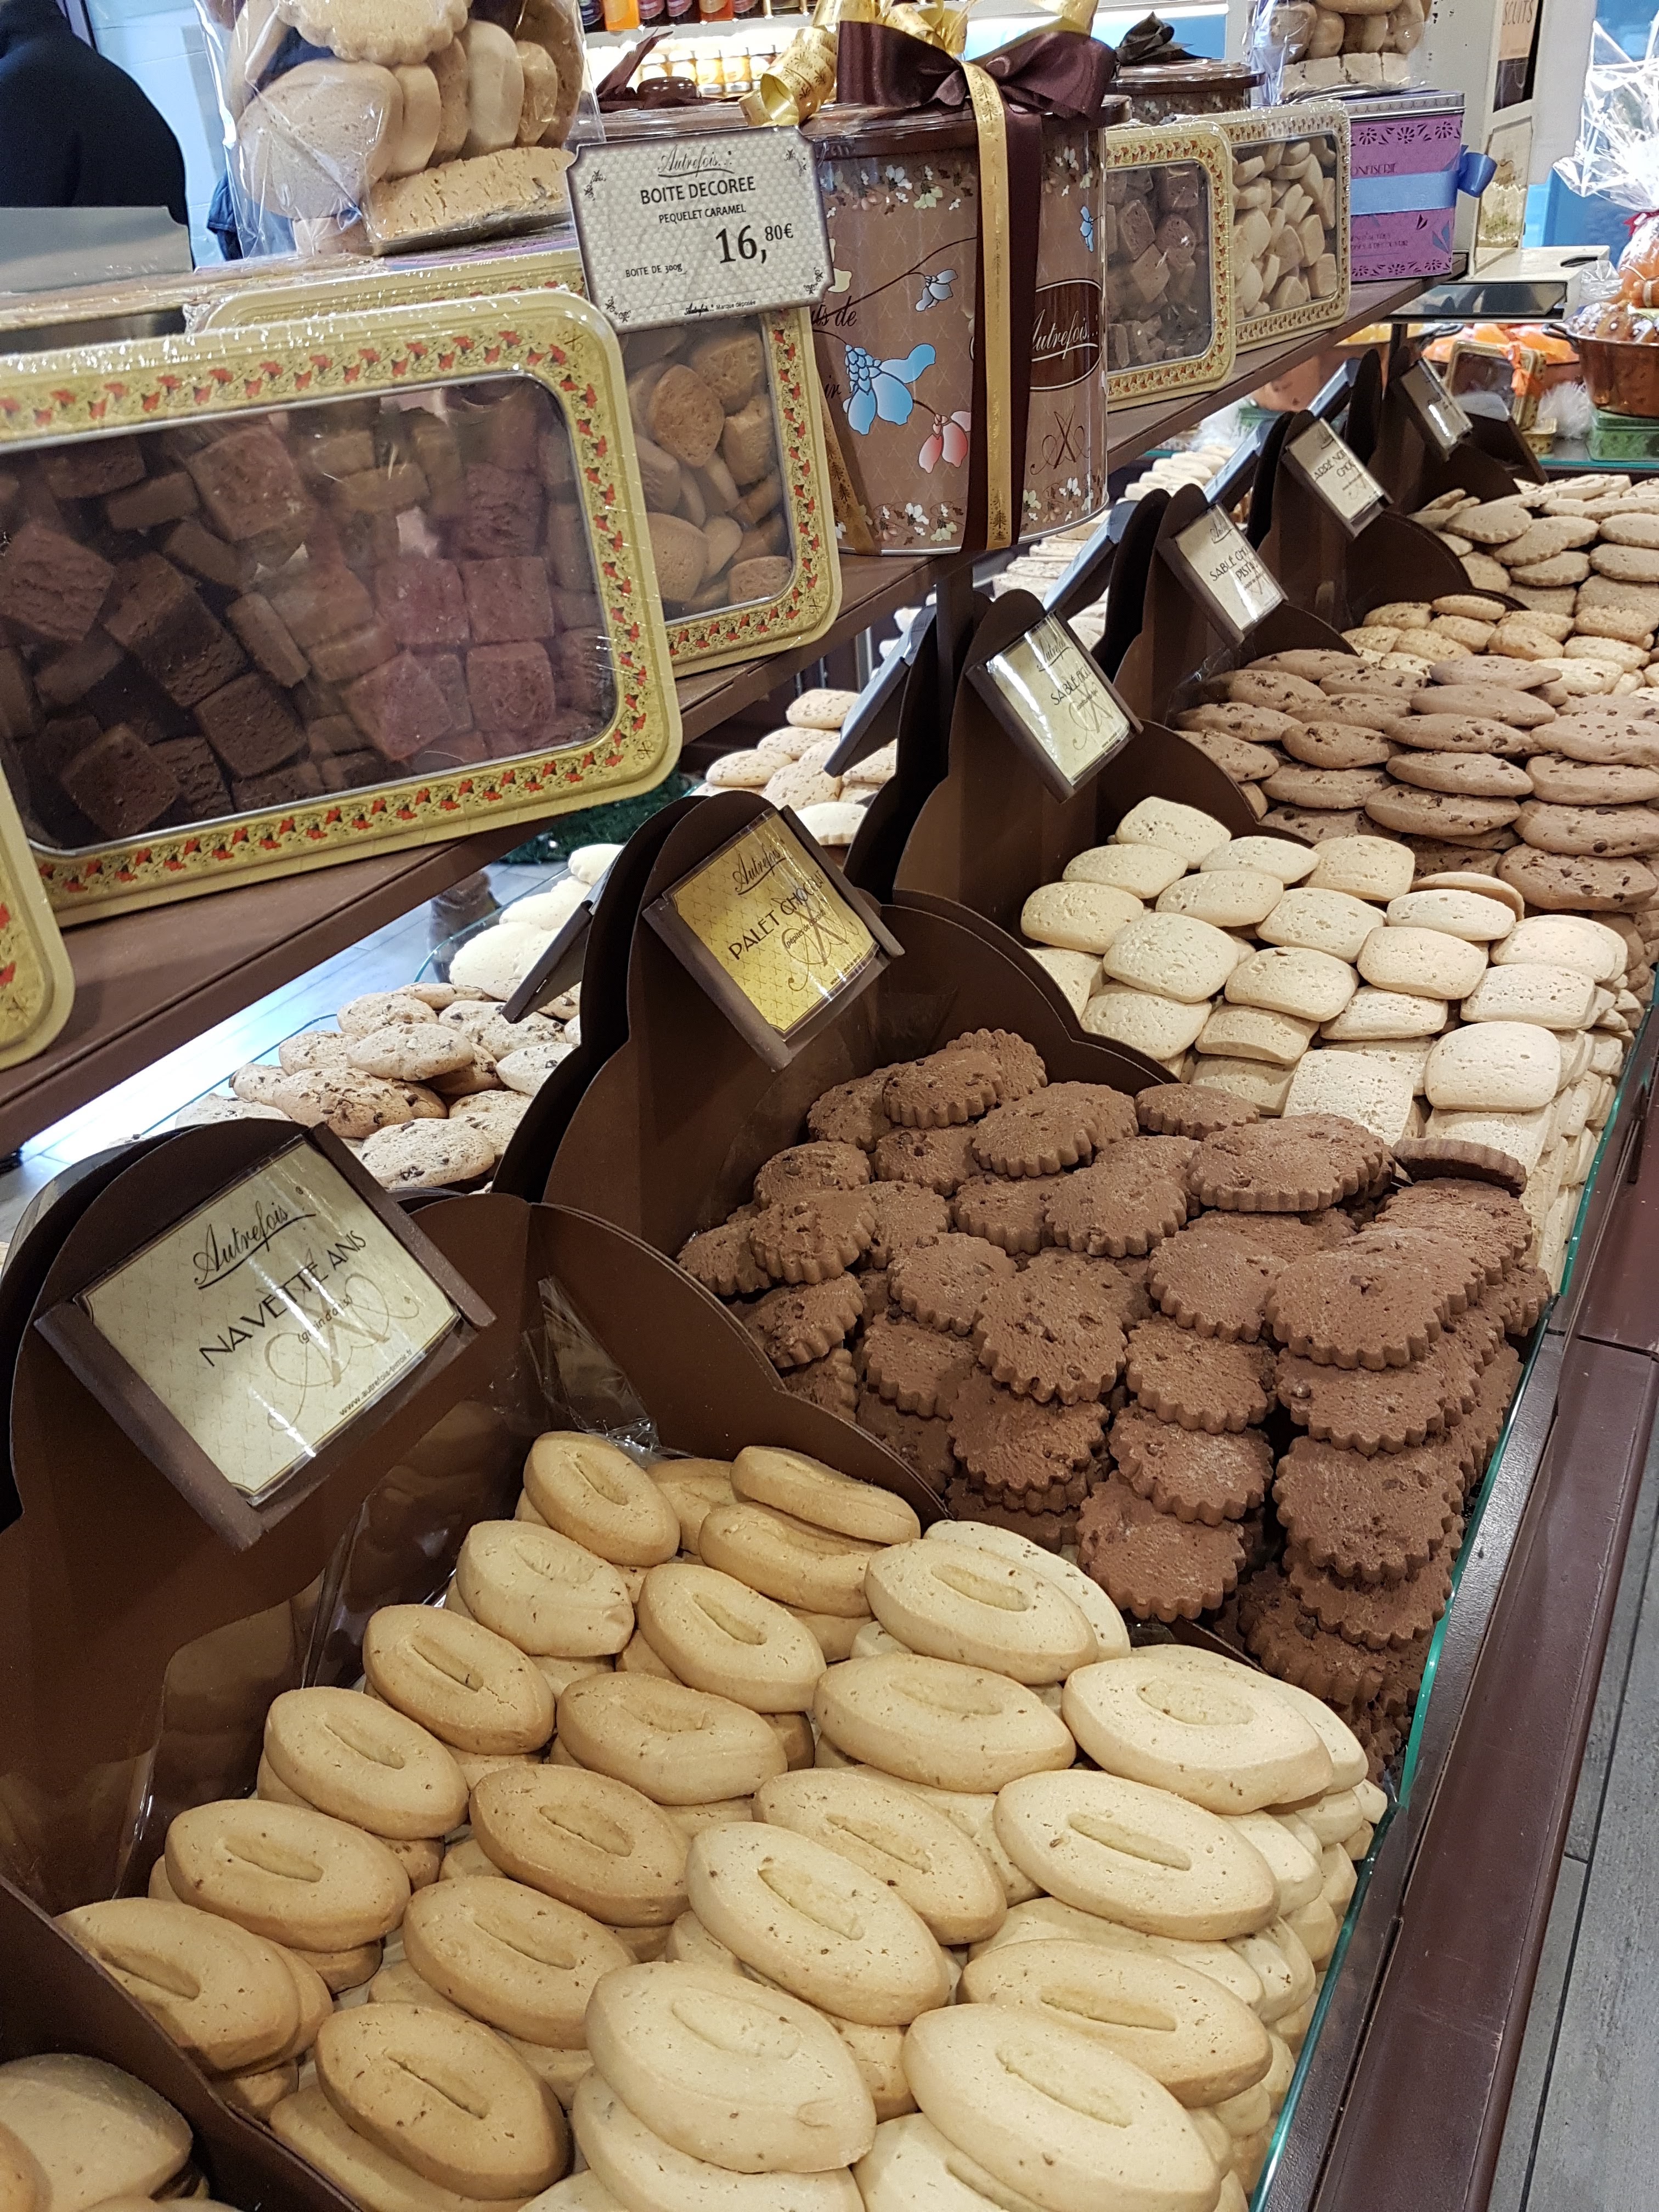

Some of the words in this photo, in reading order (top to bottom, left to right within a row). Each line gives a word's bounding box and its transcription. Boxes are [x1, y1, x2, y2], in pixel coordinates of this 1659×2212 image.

[640, 184, 685, 205] BOITE
[688, 176, 756, 199] DECOREE
[659, 209, 702, 224] PEQUELET
[705, 204, 746, 217] CARAMEL
[625, 267, 648, 278] BOITE
[651, 266, 662, 274] DE
[665, 263, 682, 274] 300g
[835, 295, 857, 326] de
[729, 910, 780, 960] PALET
[199, 1261, 329, 1367] NAVETTE
[326, 1230, 366, 1271] ANIS
